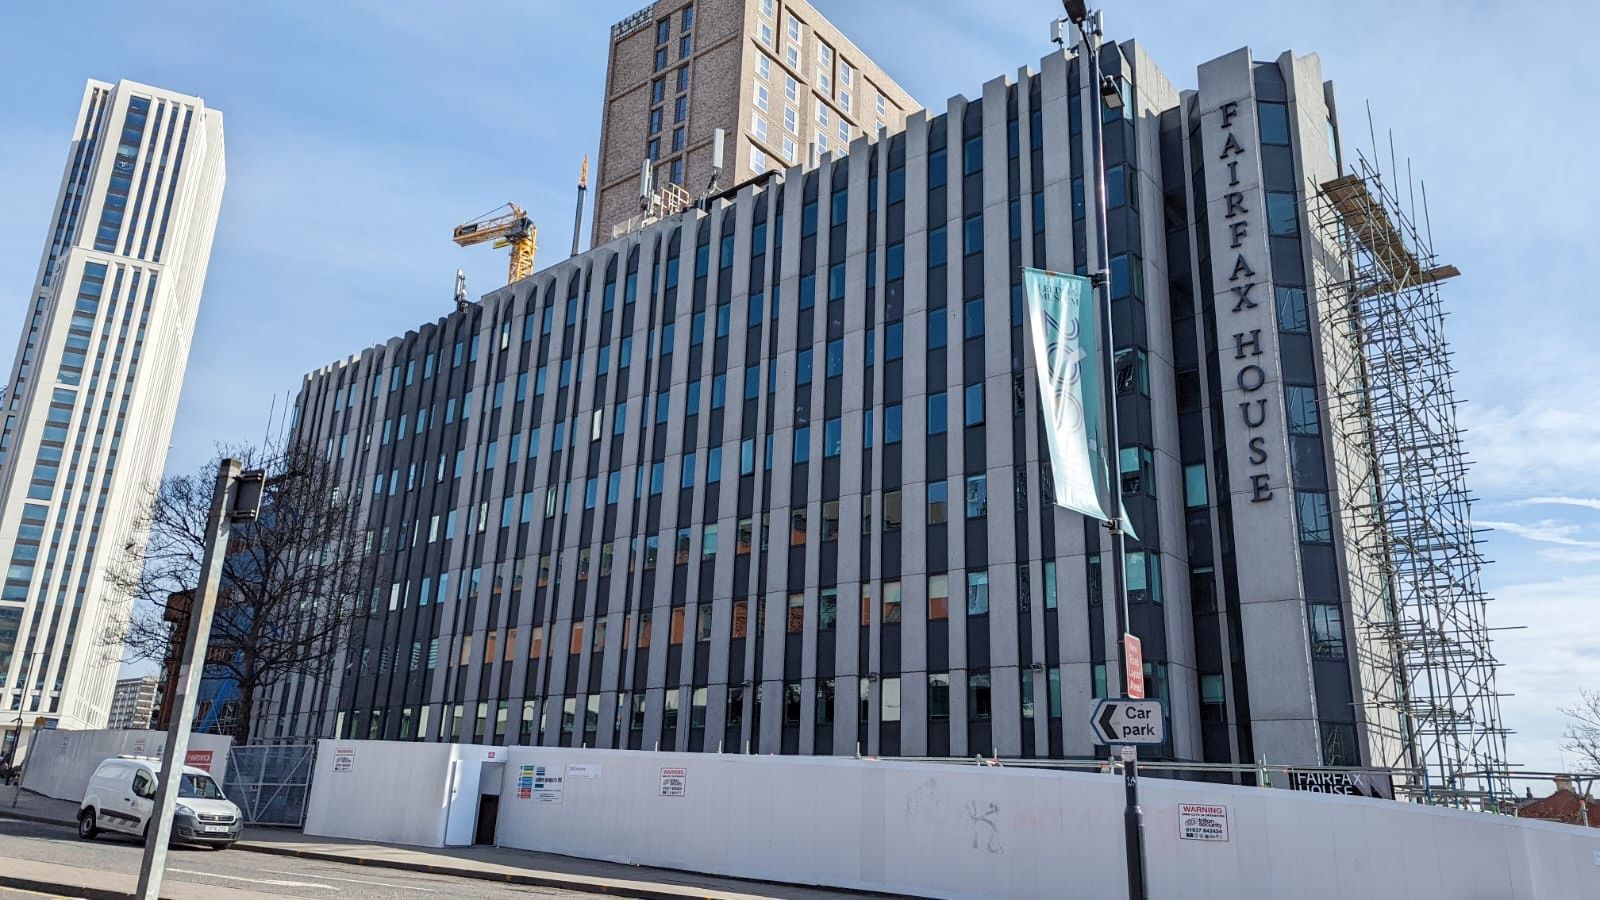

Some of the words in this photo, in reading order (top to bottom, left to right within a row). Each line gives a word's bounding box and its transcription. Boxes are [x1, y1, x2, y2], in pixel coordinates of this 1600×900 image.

[1219, 101, 1258, 312] FAIRFAX
[1233, 329, 1273, 503] HOUSE
[1125, 706, 1151, 719] Car
[1123, 723, 1156, 738] park
[1297, 772, 1364, 785] FAIRFAX
[1183, 806, 1223, 814] WARNING
